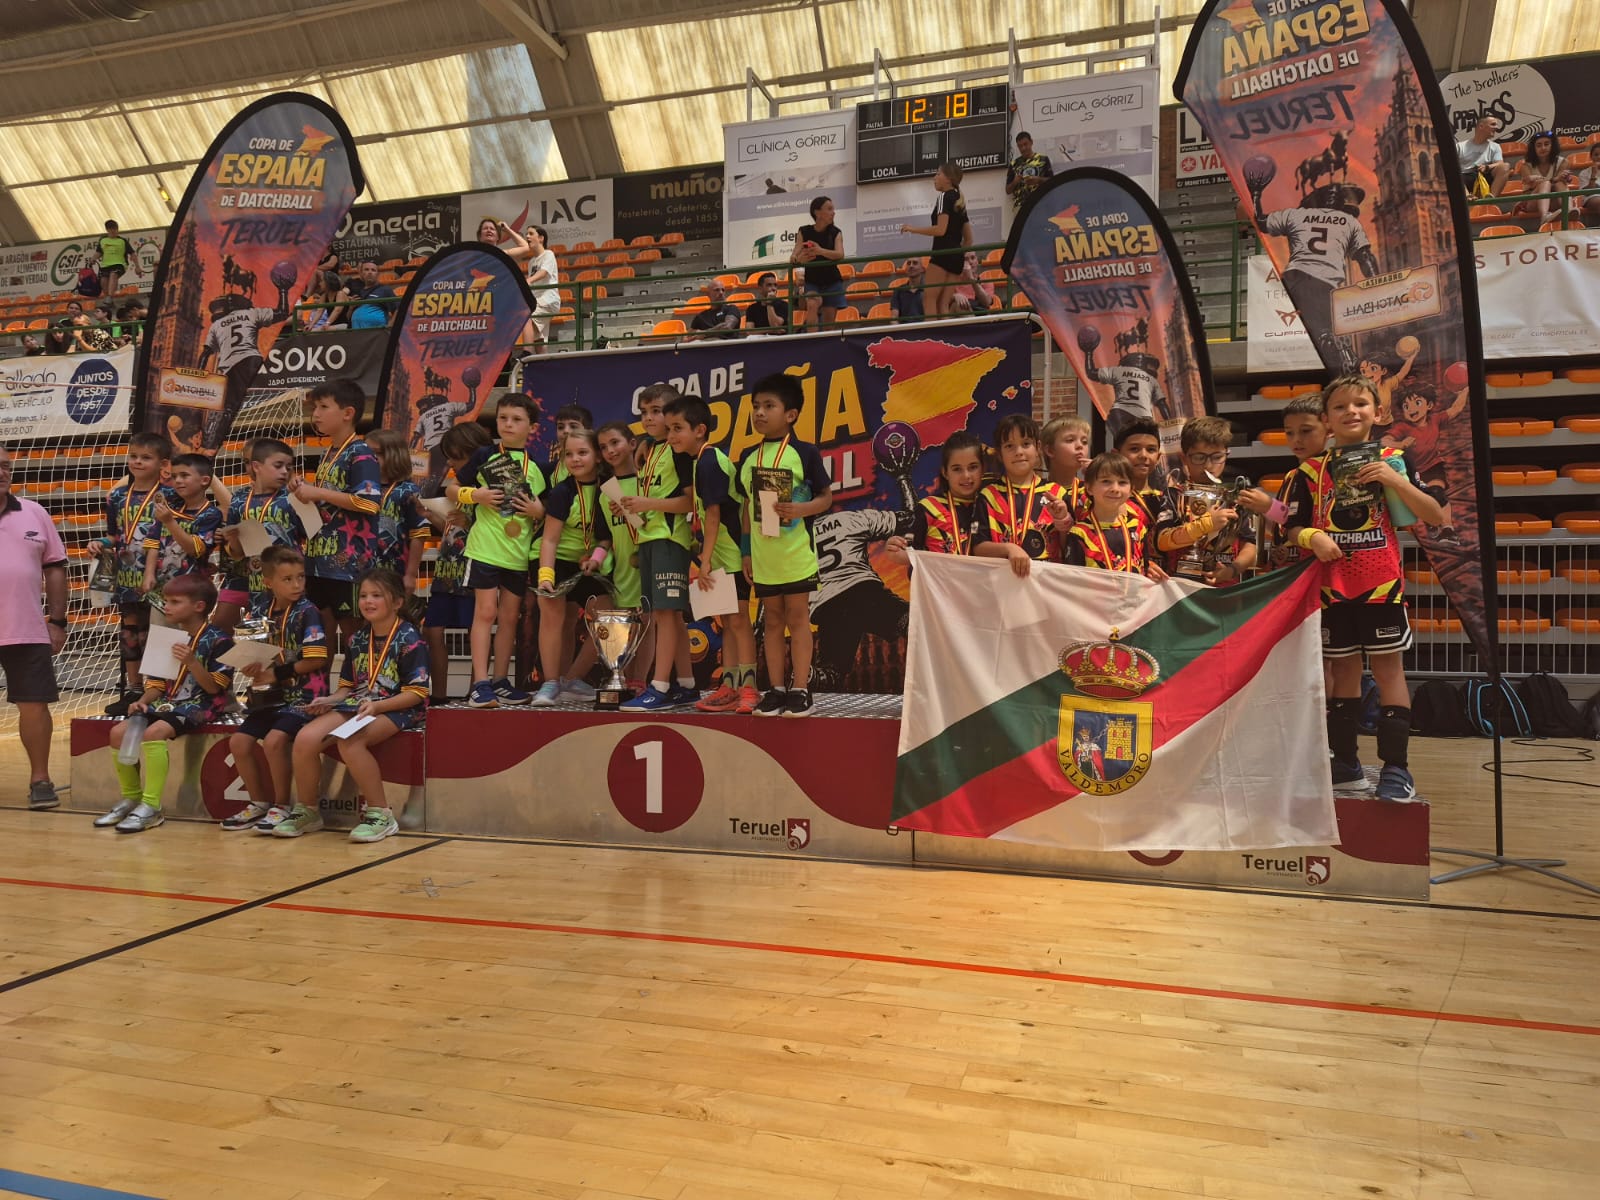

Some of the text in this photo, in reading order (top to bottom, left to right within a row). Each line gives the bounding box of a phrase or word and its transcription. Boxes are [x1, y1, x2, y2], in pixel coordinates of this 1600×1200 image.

[1449, 83, 1472, 99] The
[1040, 93, 1135, 116] CLÍNICA GÓRRIZ
[1555, 126, 1581, 135] Plaza
[249, 137, 294, 151] COPA DE
[746, 133, 837, 155] CLÍNICA GÓRRIZ
[215, 150, 327, 188] ESPAÑA
[956, 153, 1000, 167] VISITANTE
[872, 166, 899, 178] LOCAL
[650, 173, 724, 200] muño
[220, 191, 313, 210] DE DATCHBALL
[541, 194, 597, 225] IAC
[220, 217, 312, 249] TERUEL
[332, 235, 397, 250] ESTAURANTE
[58, 254, 83, 269] CSIF
[432, 280, 466, 290] COPA DE
[411, 287, 493, 317] ESPAÑA
[417, 319, 488, 333] DE DATCHBALL
[231, 324, 244, 348] 5
[419, 338, 489, 362] TERUEL
[0, 368, 57, 391] allado
[75, 370, 114, 385] JUNTOS
[709, 361, 744, 398] DE
[76, 386, 110, 398] DESDE
[433, 415, 444, 432] 5
[816, 535, 842, 575] 5
[633, 740, 663, 814] 1
[1059, 749, 1149, 793] VALDEMORO
[320, 795, 357, 812] eruel
[729, 817, 786, 837] Teruel
[1242, 854, 1303, 873] Teruel
